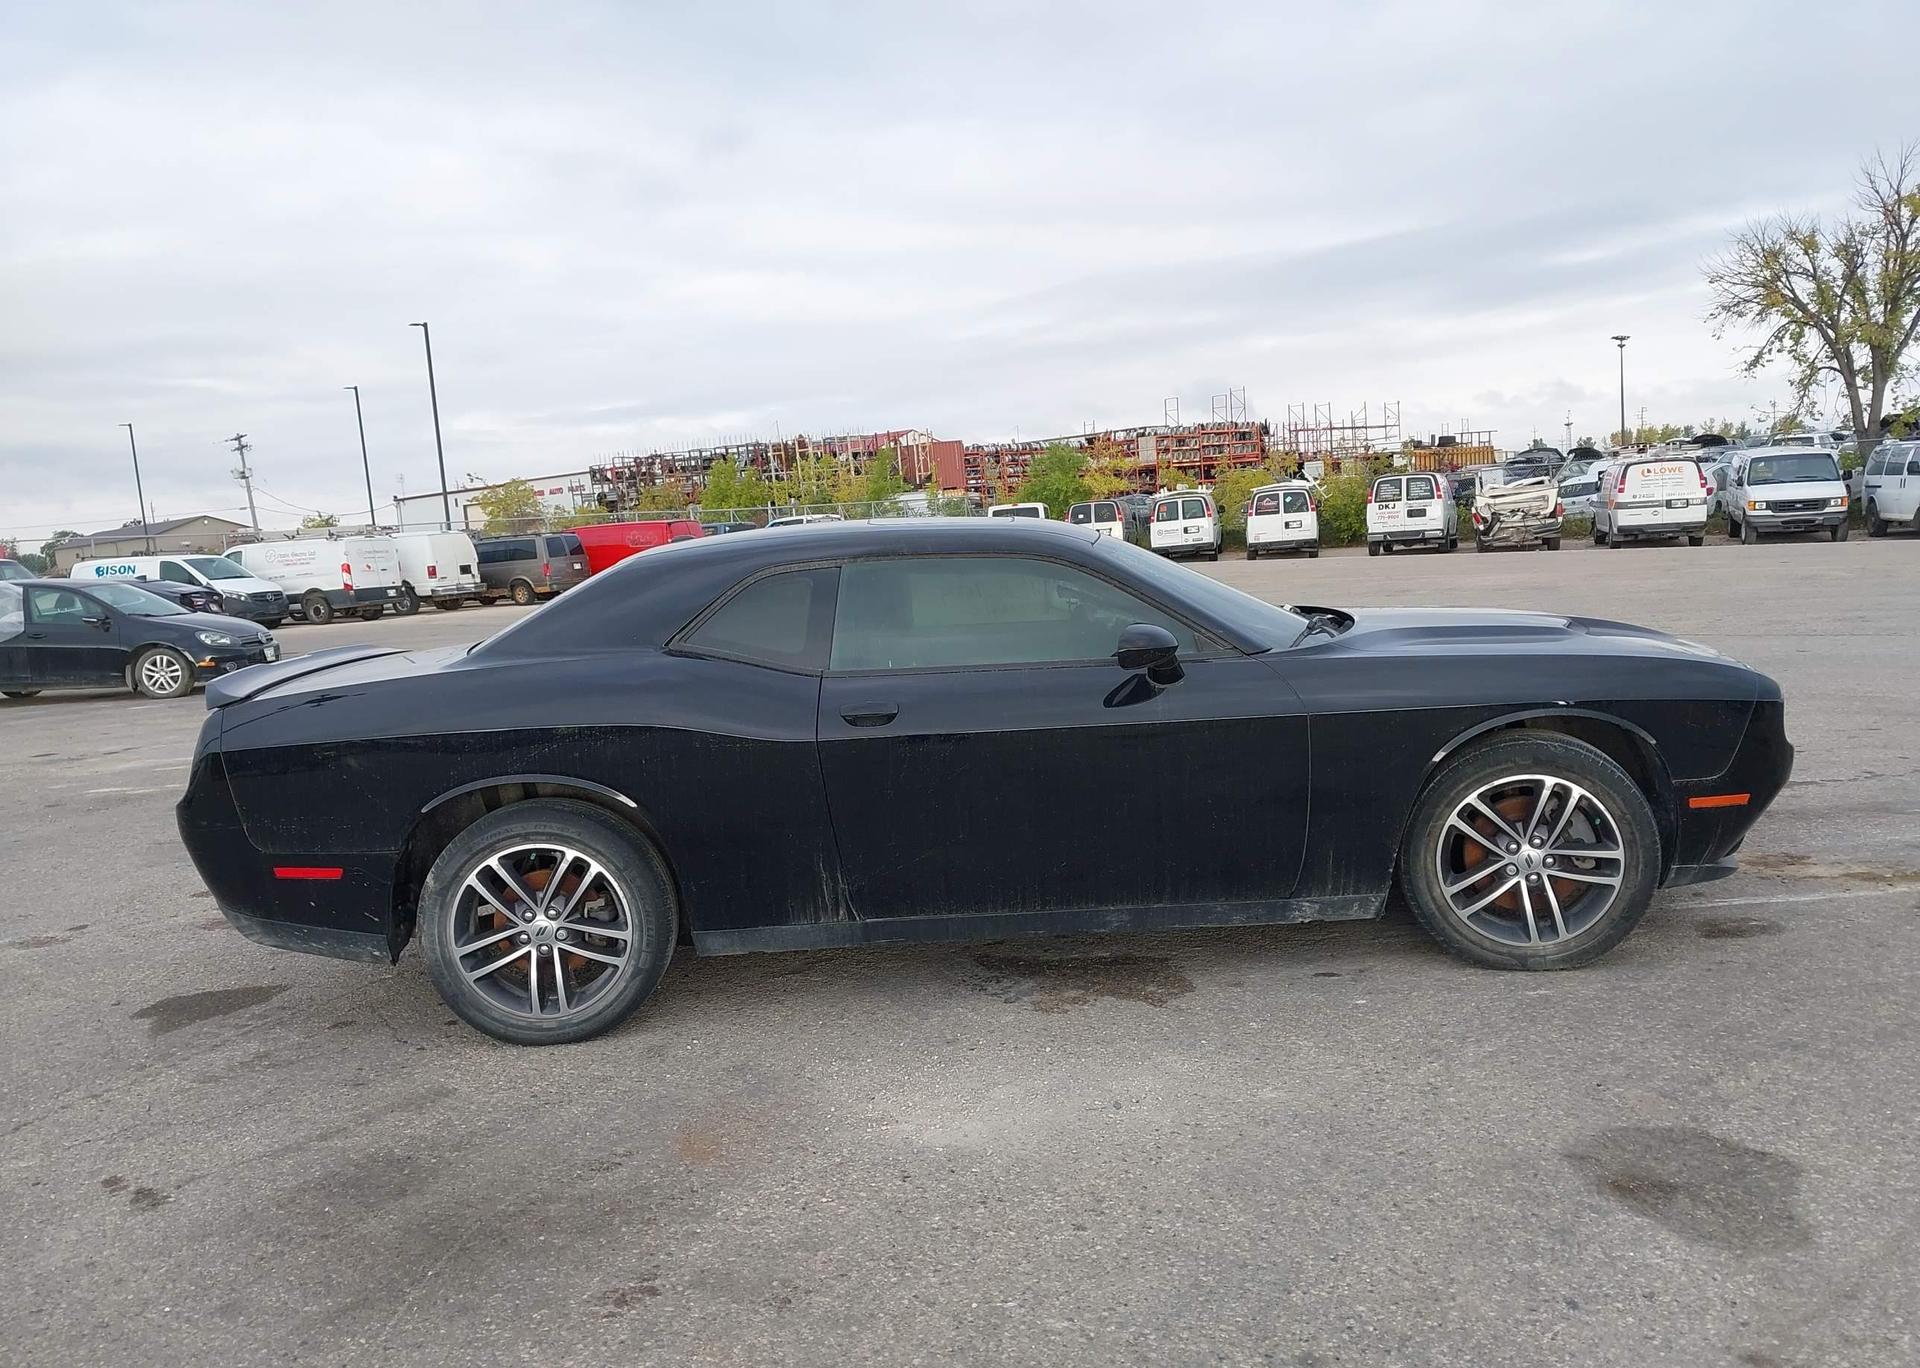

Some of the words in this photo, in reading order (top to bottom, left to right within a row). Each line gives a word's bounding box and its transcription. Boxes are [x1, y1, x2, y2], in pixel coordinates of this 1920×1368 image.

[1653, 466, 1685, 475] LOWE
[549, 487, 563, 495] AUTO
[1378, 503, 1396, 511] DKJ
[95, 564, 136, 577] BISON
